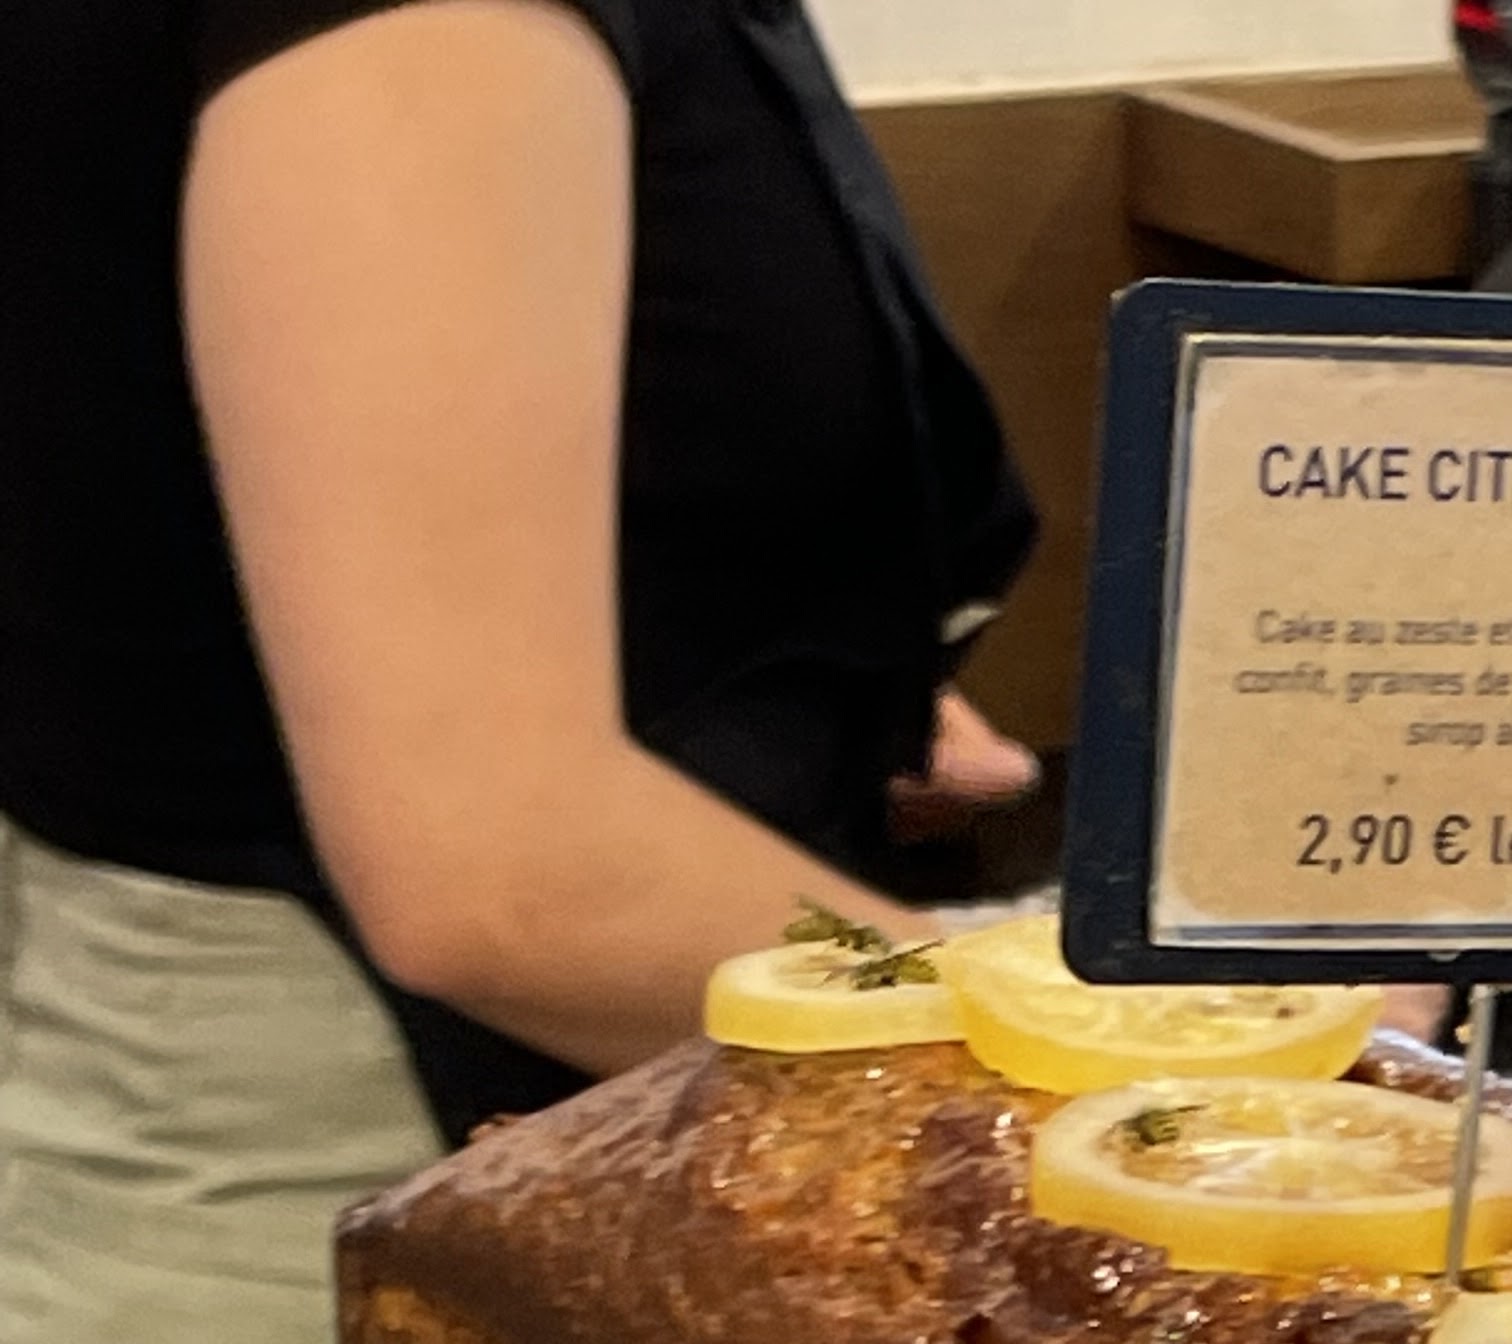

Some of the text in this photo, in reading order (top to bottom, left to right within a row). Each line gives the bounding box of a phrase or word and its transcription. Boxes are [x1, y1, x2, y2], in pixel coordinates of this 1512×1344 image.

[1257, 444, 1410, 501] CAKE
[1256, 609, 1335, 644] Cake
[1345, 620, 1385, 644] au
[1295, 813, 1414, 875] 2,90
[1431, 813, 1472, 866] €
